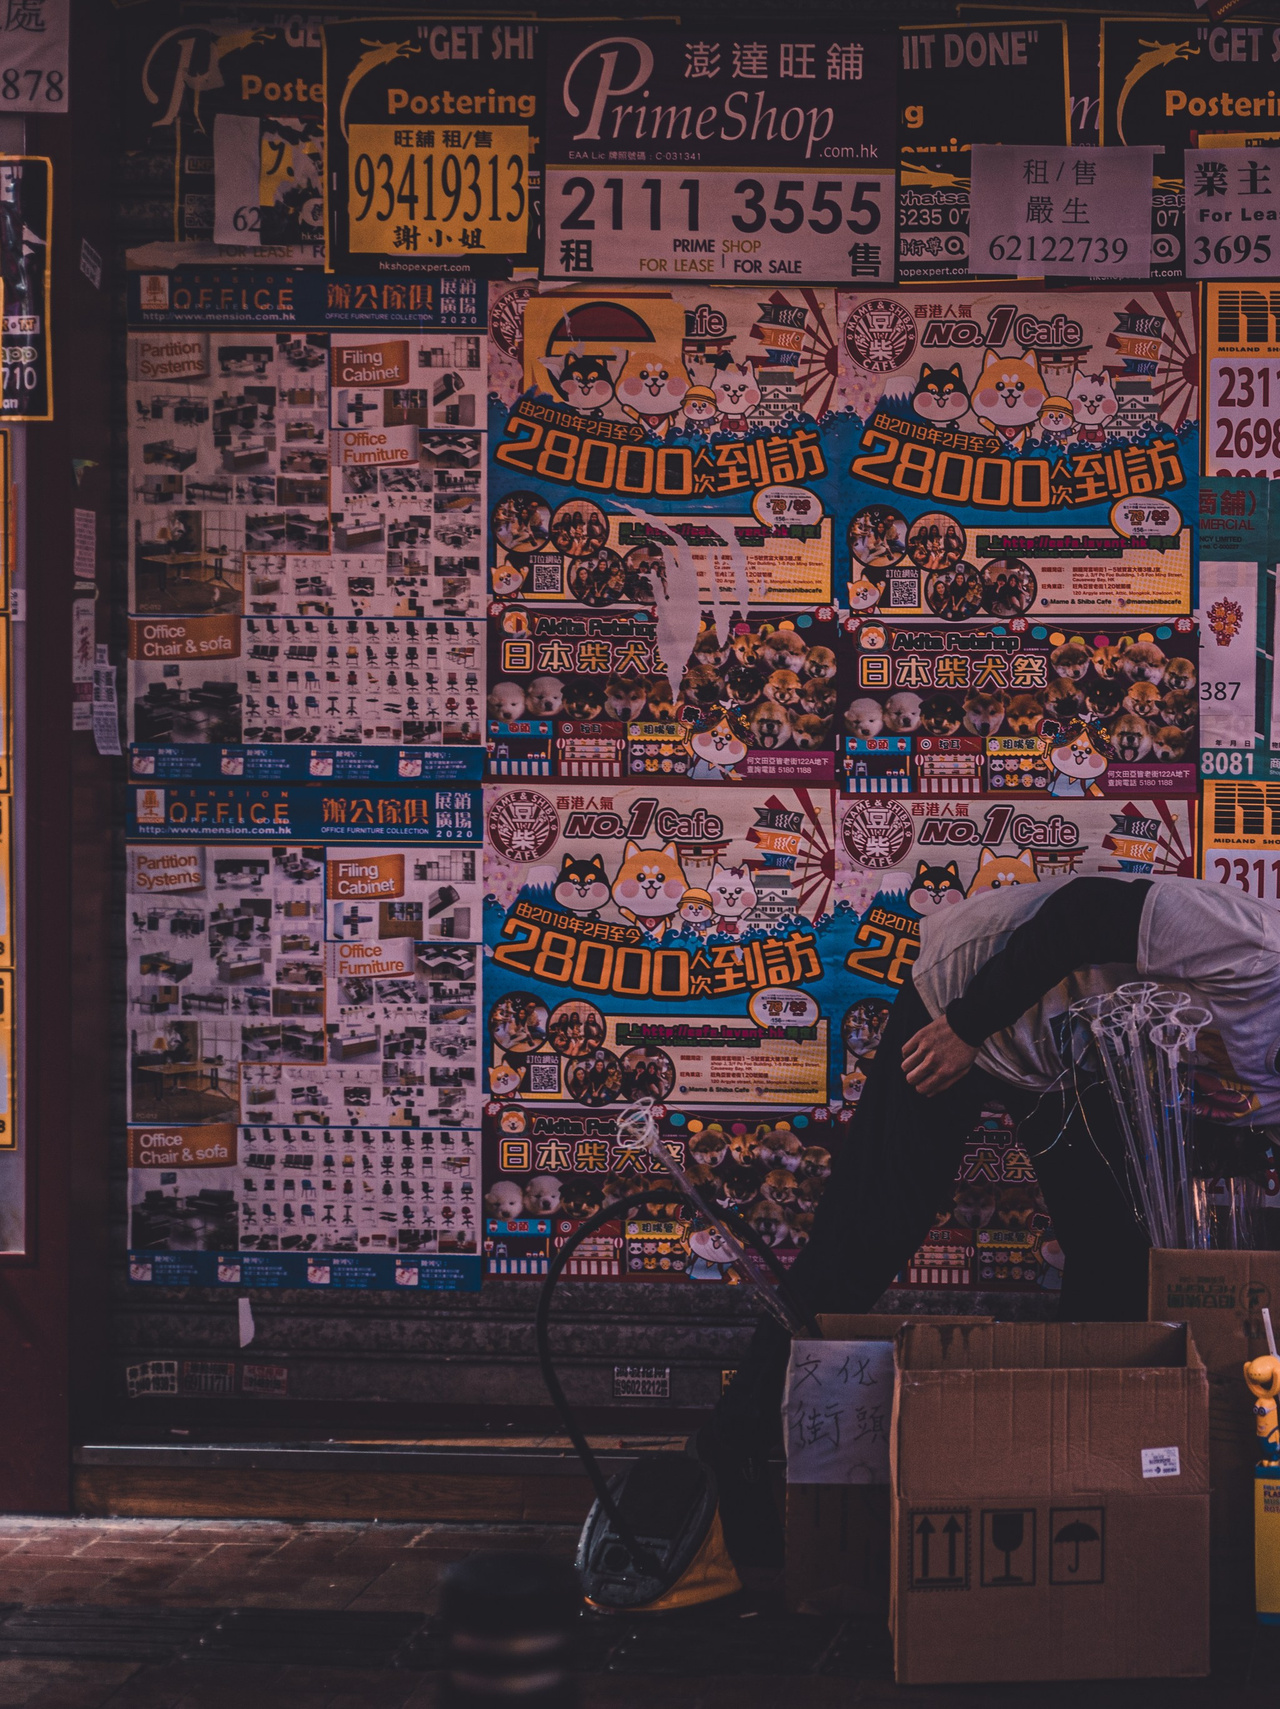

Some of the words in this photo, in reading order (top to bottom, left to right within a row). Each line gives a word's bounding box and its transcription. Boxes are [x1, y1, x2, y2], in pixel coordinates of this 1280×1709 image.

[684, 42, 864, 81] 澎達旺舖
[387, 88, 537, 117] Postering
[562, 36, 835, 159] PrimeShop
[355, 153, 526, 222] 93419313
[559, 176, 700, 231] 2111
[730, 178, 881, 235] 3555
[1200, 209, 1233, 222] For
[393, 226, 485, 251] 謝小姐
[673, 238, 715, 253] PRIME
[722, 239, 761, 254] SHOP
[559, 239, 594, 273] 租
[988, 235, 1128, 264] 62122739
[1193, 234, 1272, 265] 3695
[379, 261, 471, 273] hkshopexpert.com
[639, 258, 668, 272] FOR
[674, 259, 715, 273] LEASE
[734, 259, 762, 274] FOR
[769, 259, 802, 274] SALE
[848, 242, 882, 277] 售
[914, 304, 972, 318] 香港人氣
[1016, 315, 1083, 346] Cafe
[863, 359, 897, 371] CAFE
[874, 413, 1000, 454] 由2019年2月至今
[859, 655, 1048, 689] 日本柴犬祭
[777, 766, 794, 774] 5180
[795, 766, 812, 774] 1188
[170, 790, 289, 798] MENSION
[169, 802, 289, 823] OFFICE
[322, 797, 429, 824] 辦公傢俱
[138, 824, 292, 835] http://www.mension.com.hk
[436, 830, 473, 838] 2020
[137, 854, 198, 869] Partition
[338, 863, 378, 879] Filing
[137, 872, 201, 888] Systems
[338, 878, 395, 894] Cabinet
[339, 945, 382, 959] Office
[339, 961, 404, 975] Furniture
[139, 1133, 183, 1148] Office
[139, 1149, 178, 1165] Chair
[196, 1145, 228, 1160] sofa
[794, 1354, 877, 1391] 文化
